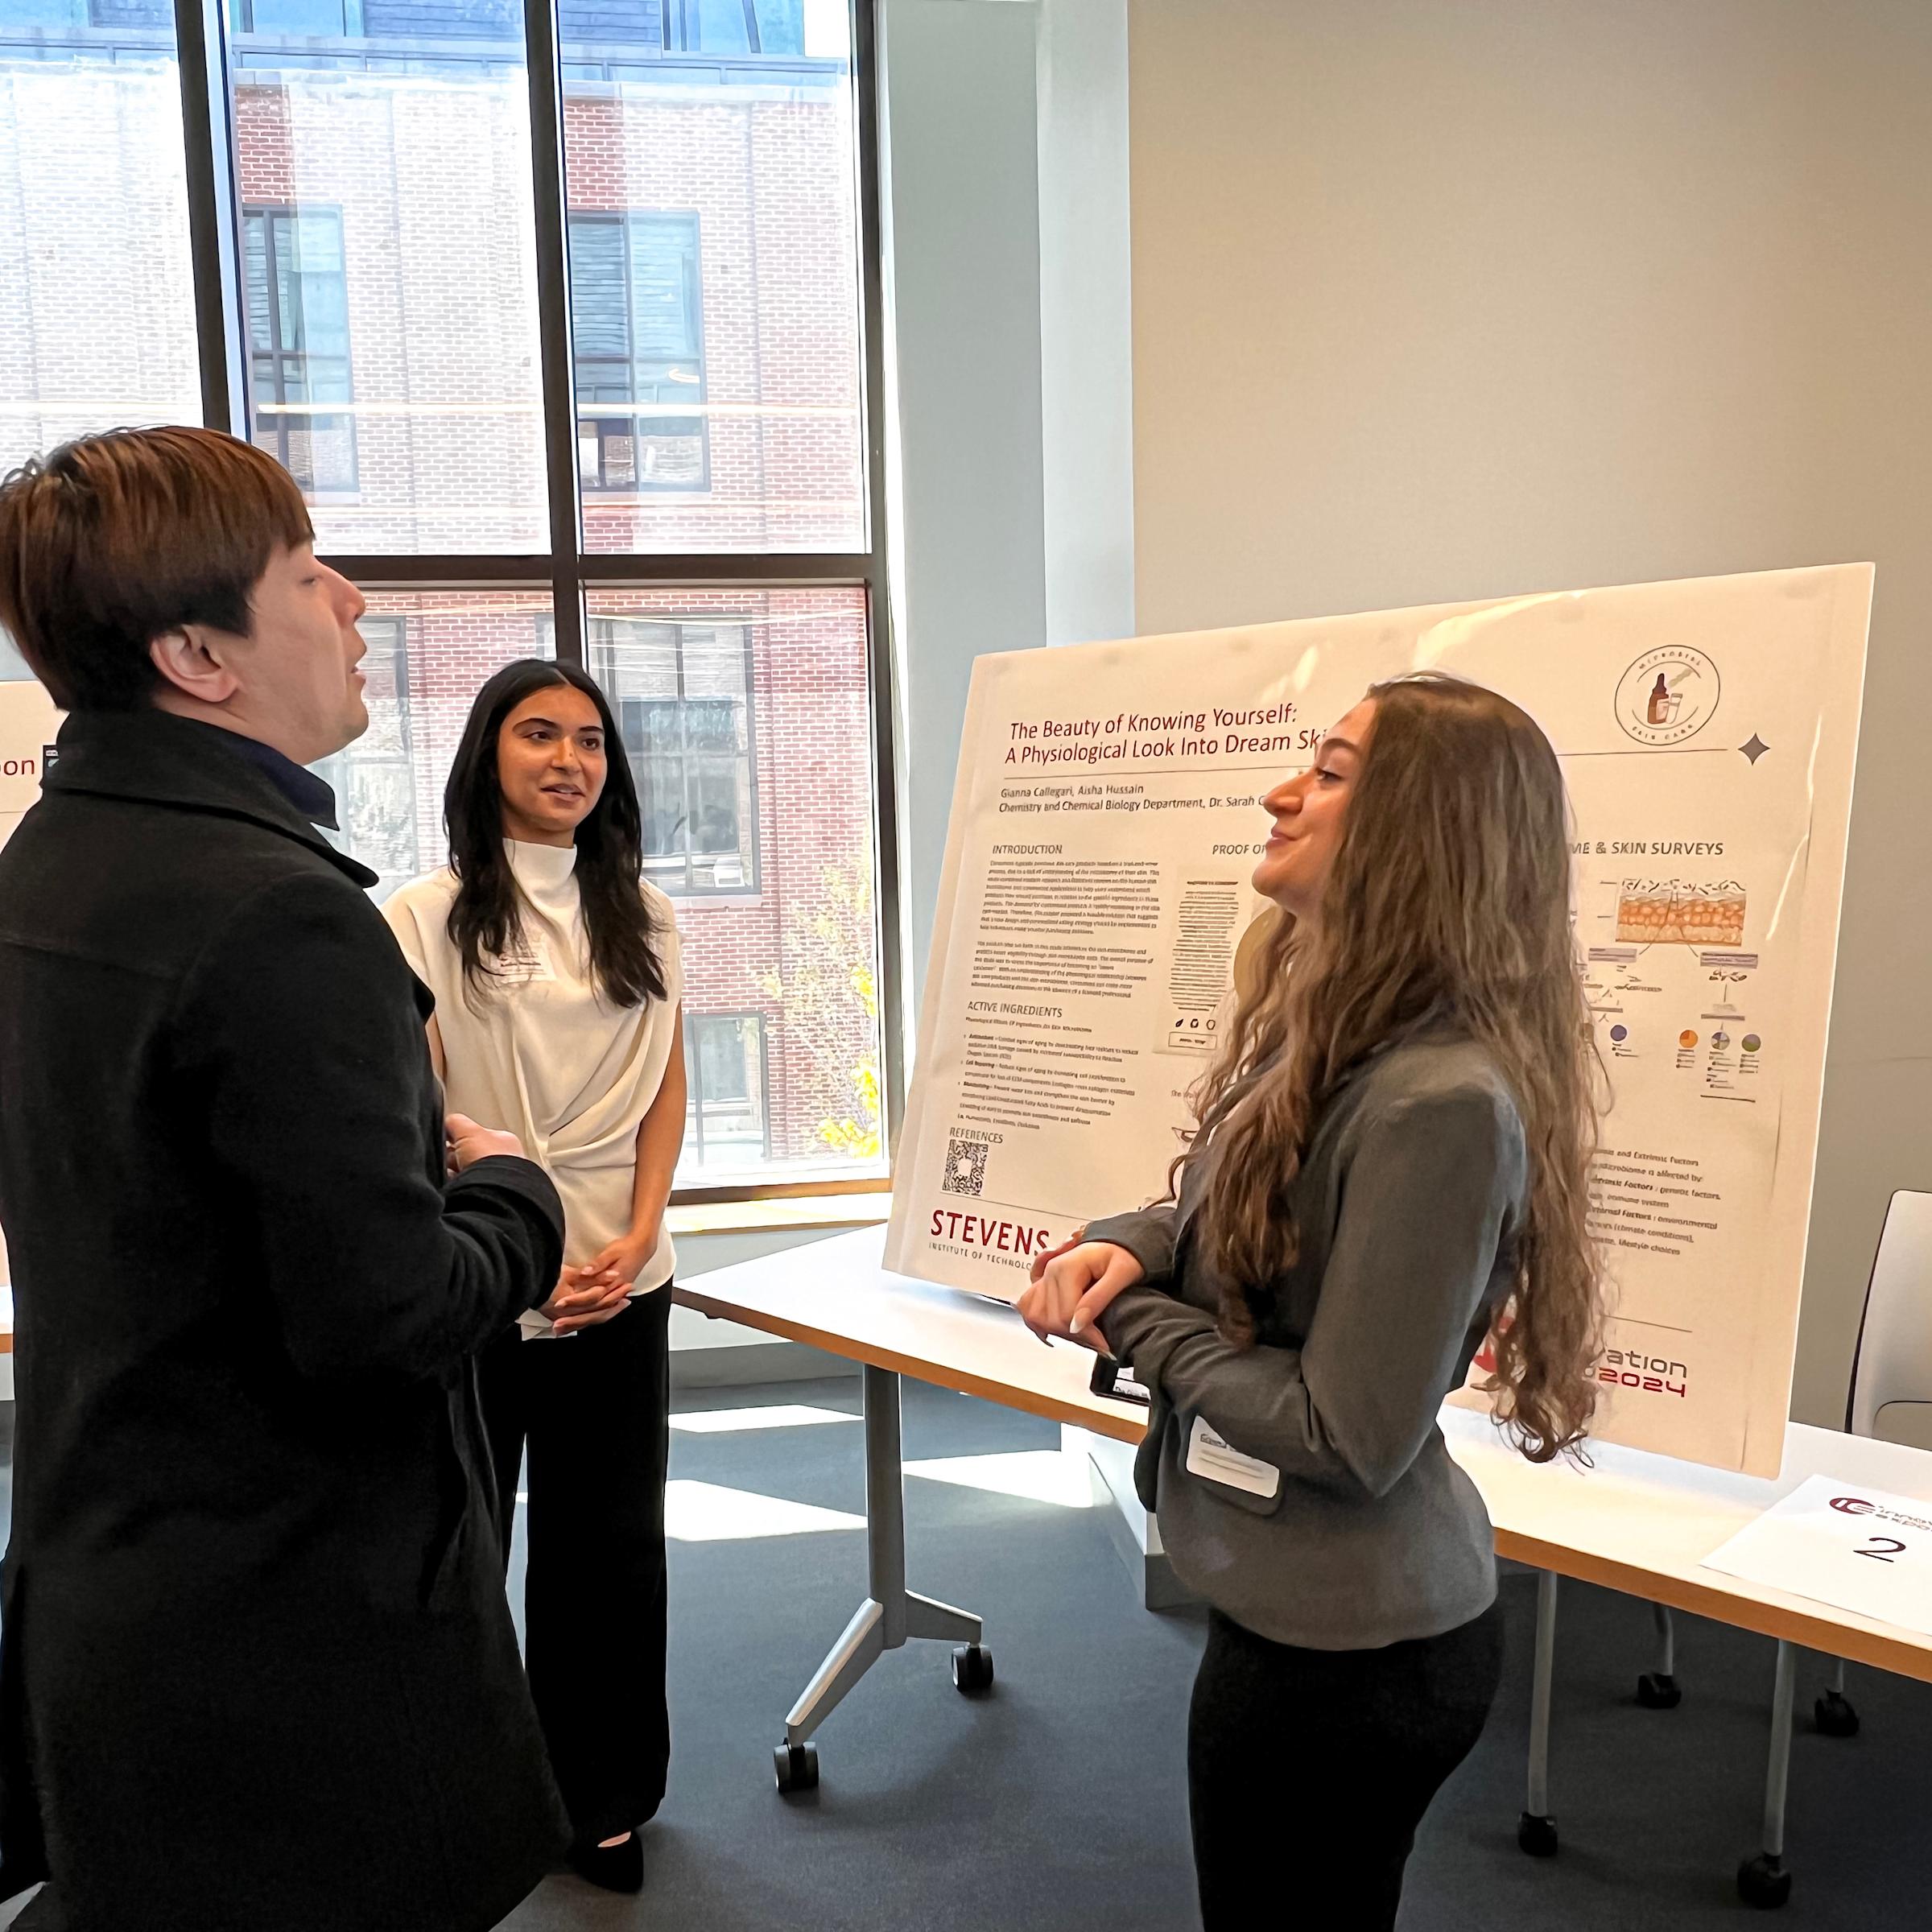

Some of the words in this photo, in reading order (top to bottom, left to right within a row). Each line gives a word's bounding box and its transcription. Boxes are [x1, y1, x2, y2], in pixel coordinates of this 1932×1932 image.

[1011, 722, 1038, 740] The
[1043, 720, 1100, 738] Beauty
[1105, 713, 1125, 733] of
[1128, 711, 1206, 733] Knowing
[1213, 703, 1298, 727] Yourself:
[1005, 748, 1016, 764] A
[1022, 739, 1127, 766] Physiological
[1133, 737, 1174, 758] Look
[1182, 737, 1218, 756] Into
[1226, 734, 1290, 753] Dream
[0, 759, 35, 776] on
[1001, 788, 1031, 798] Gianna
[1078, 785, 1103, 795] Aisha
[1106, 784, 1144, 795] Hussain
[999, 802, 1041, 813] Chemistry
[1044, 801, 1060, 811] and
[1062, 799, 1103, 811] Chemical
[1106, 799, 1141, 811] Biology
[1143, 798, 1205, 810] Department,
[1209, 797, 1223, 807] Dr.
[1226, 796, 1254, 806] Sarah
[993, 844, 1063, 855] INTRODUCTION
[1212, 844, 1249, 855] PROOF
[1596, 841, 1606, 854] &
[1612, 842, 1646, 854] SKIN
[1651, 842, 1724, 855] SURVEYS
[968, 1001, 997, 1013] ACTIVE
[1000, 1003, 1063, 1018] INGREDIENTS
[950, 1127, 1004, 1143] REFERENCES
[931, 1209, 1050, 1256] STEVENS
[929, 1242, 968, 1257] INSTITUTE
[972, 1251, 982, 1260] OF
[1607, 1350, 1687, 1378] ation
[1599, 1367, 1686, 1397] 2024
[1853, 1537, 1906, 1563] 2
